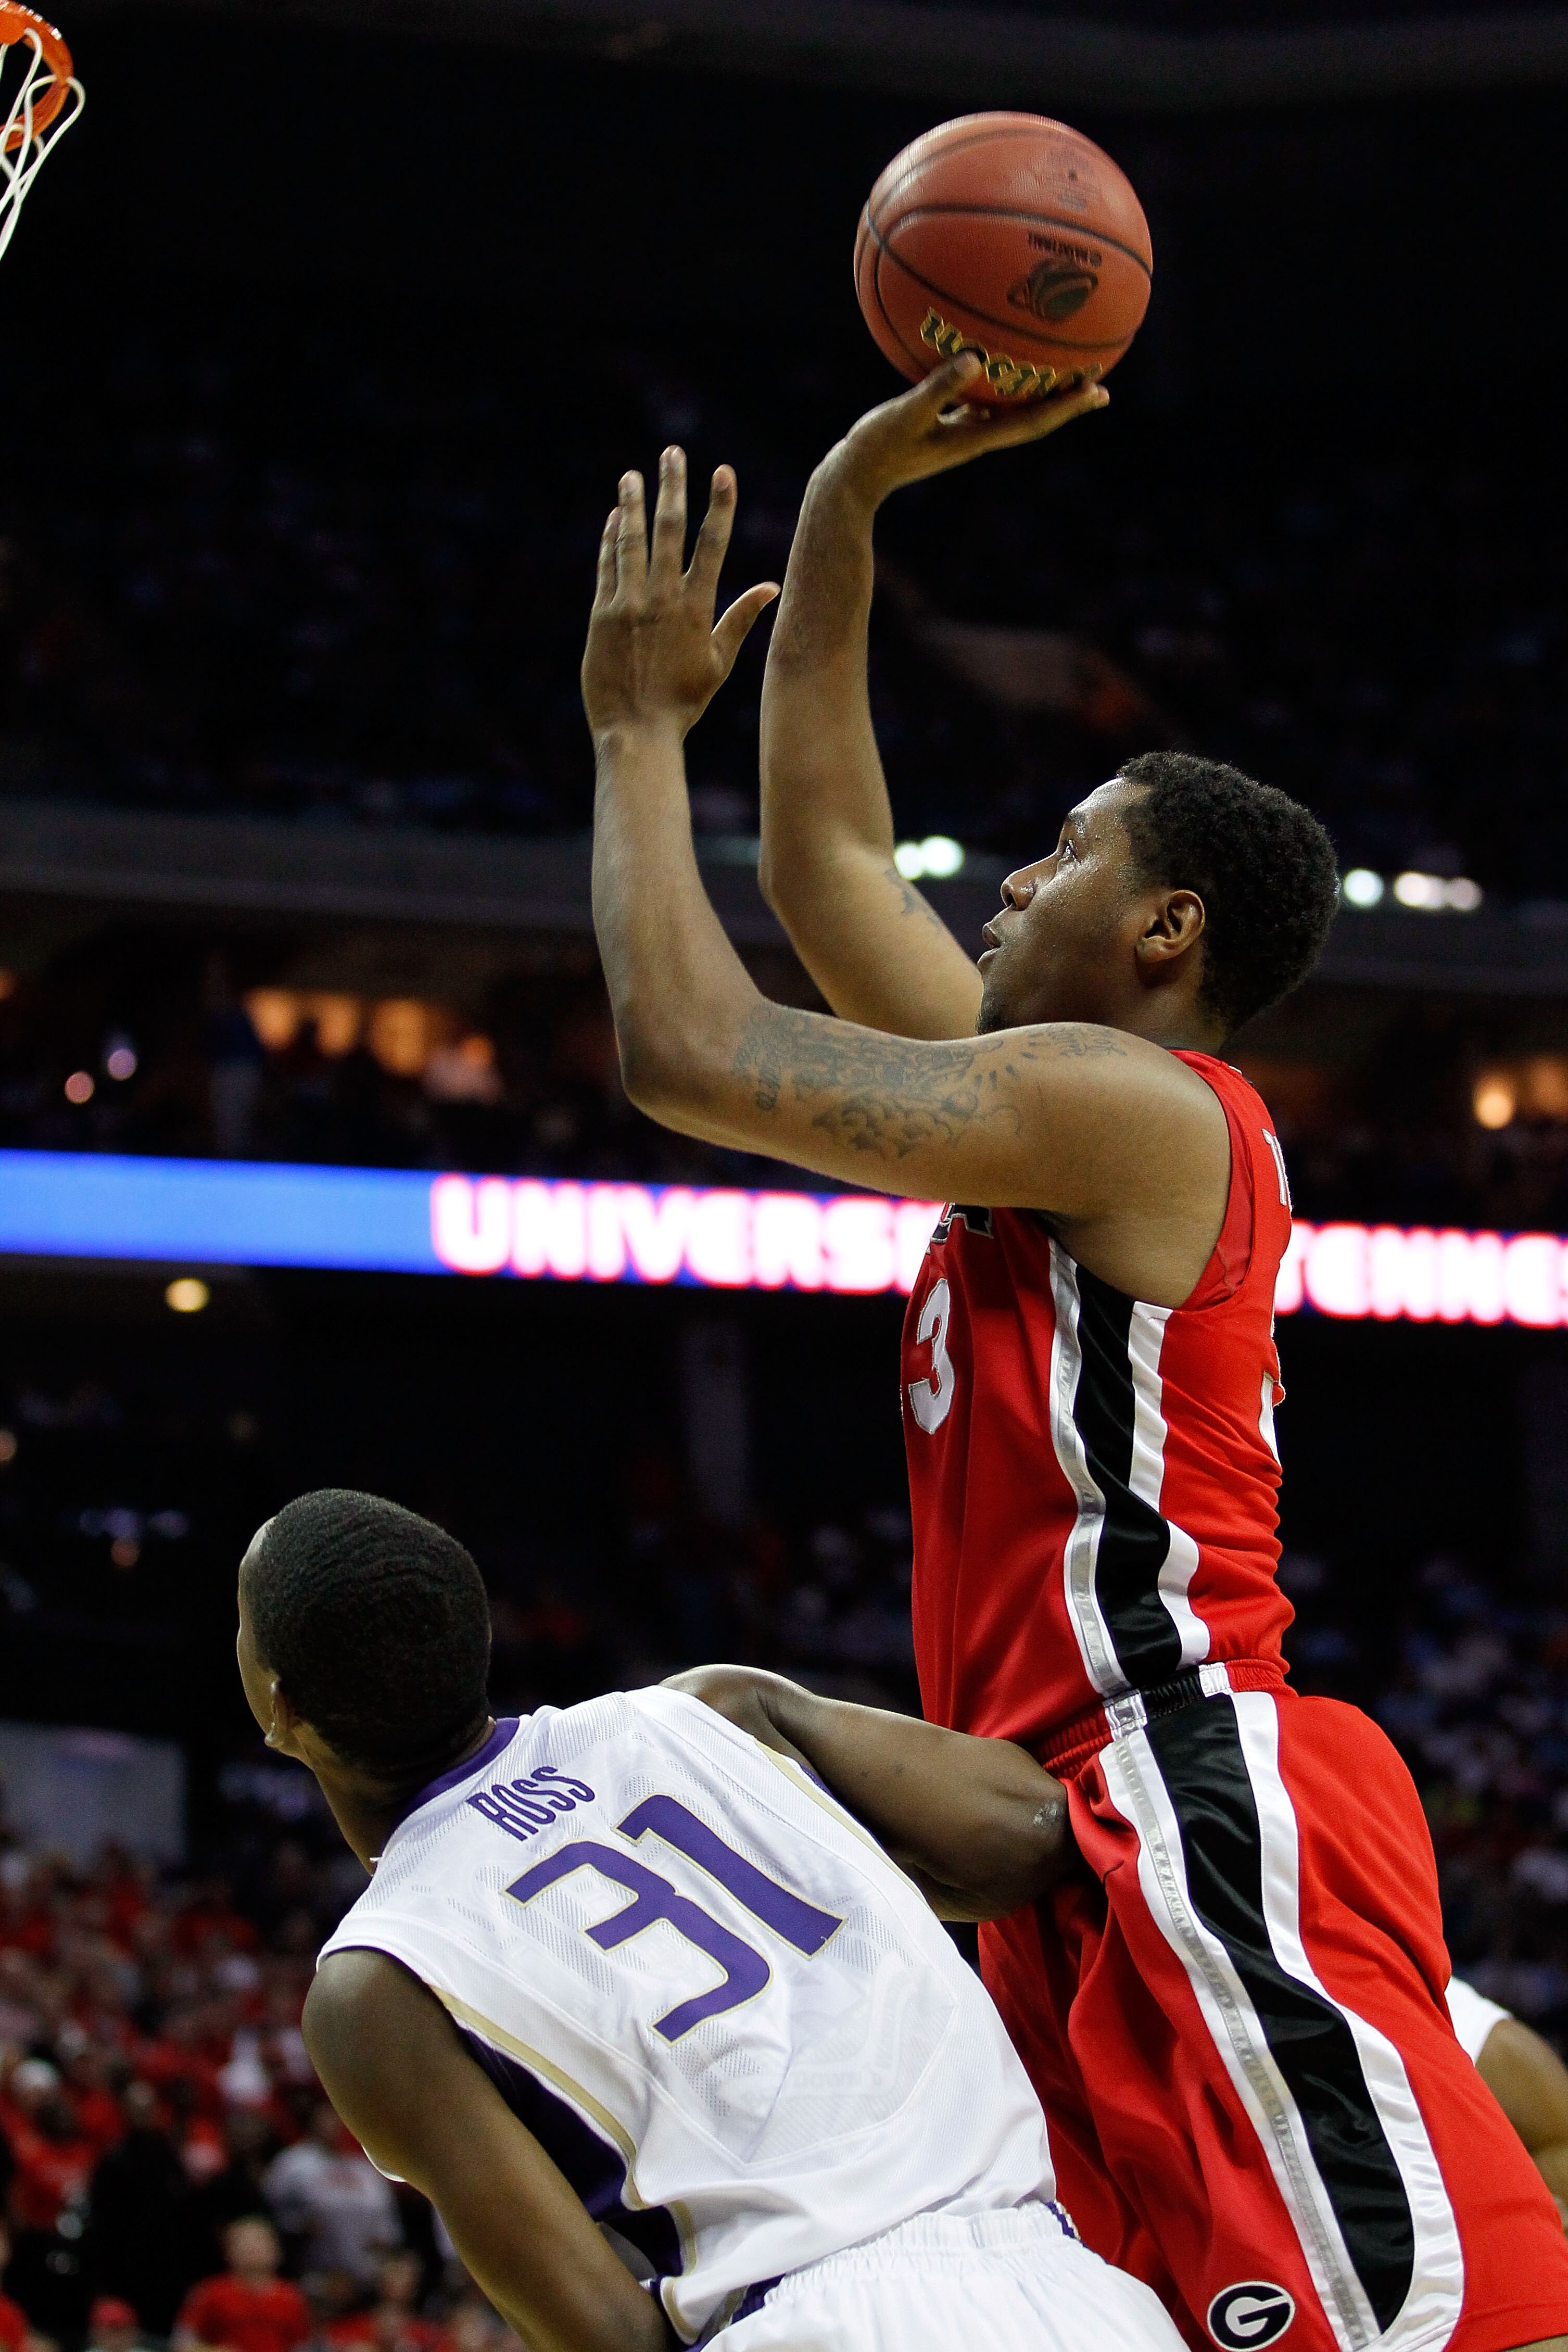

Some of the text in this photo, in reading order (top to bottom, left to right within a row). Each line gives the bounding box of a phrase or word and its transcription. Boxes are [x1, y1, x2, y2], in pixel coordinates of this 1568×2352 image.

[431, 1173, 1568, 1330] UNIVERSI TENNE
[908, 1277, 955, 1435] 3
[466, 1766, 596, 1841] ROSS
[501, 1792, 848, 2048] 31
[1207, 2281, 1296, 2351] G
